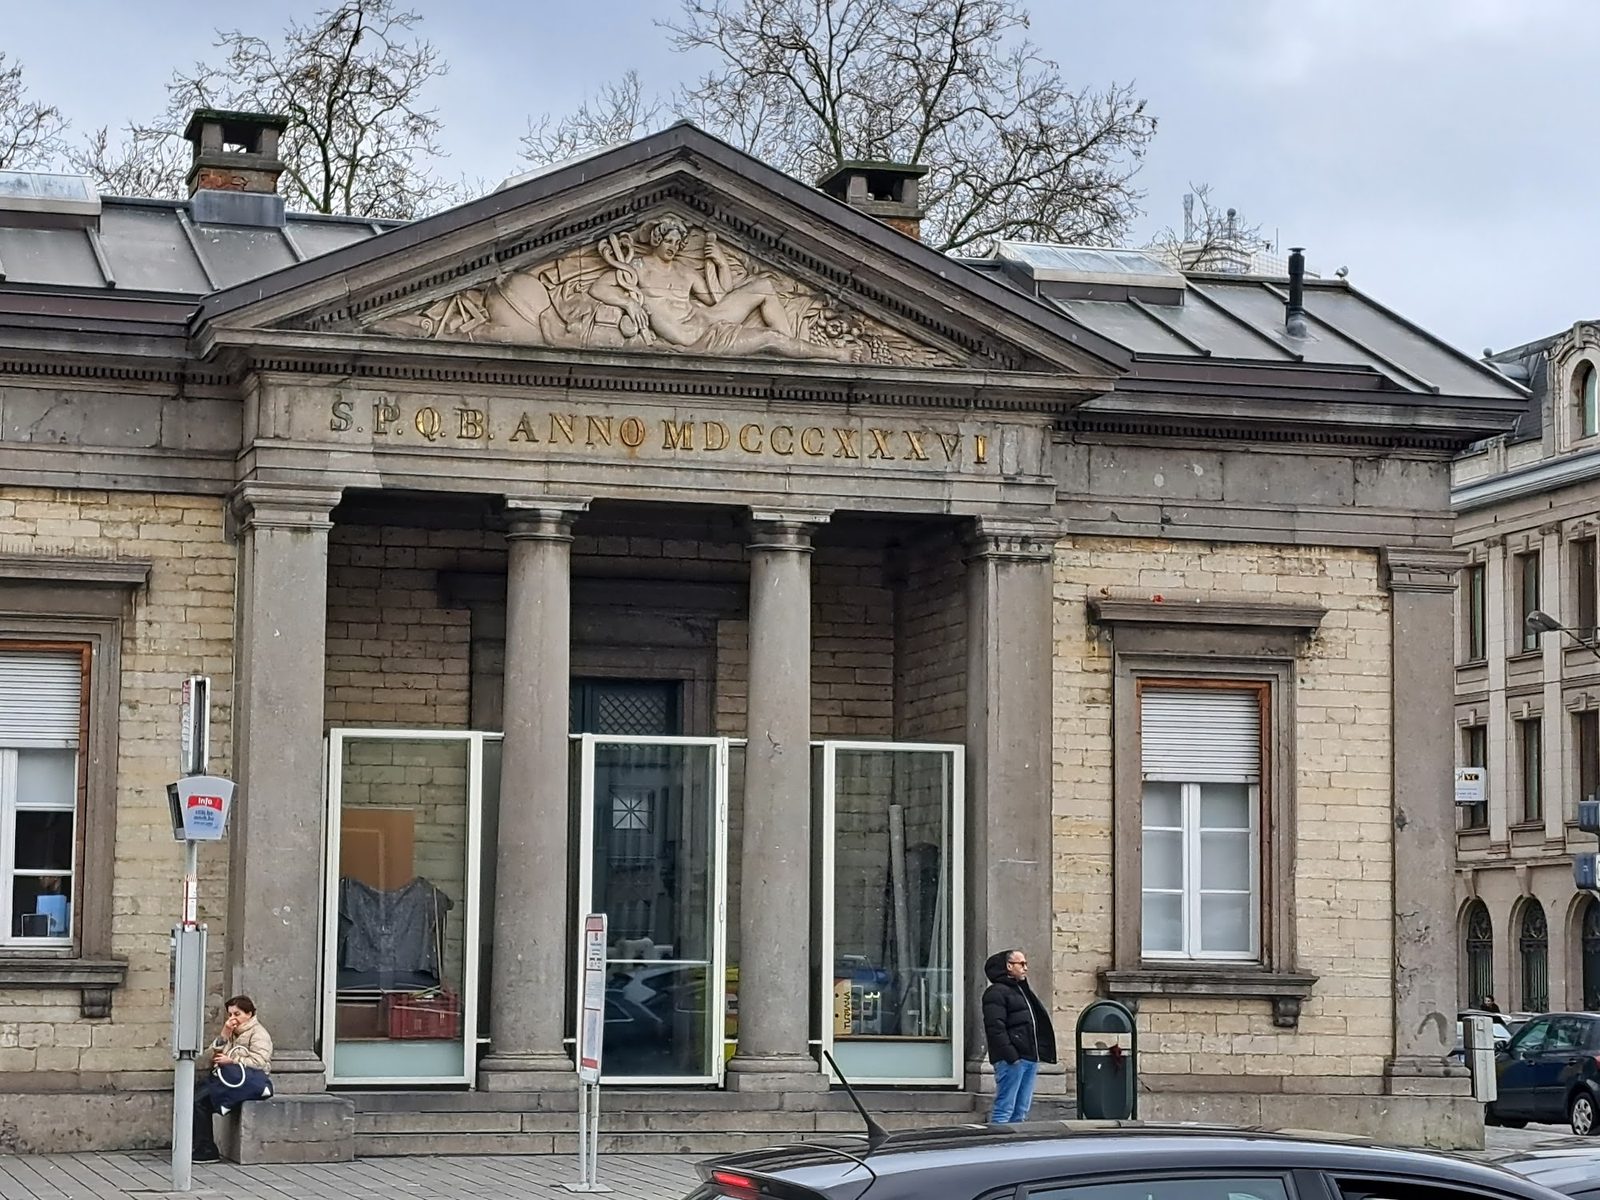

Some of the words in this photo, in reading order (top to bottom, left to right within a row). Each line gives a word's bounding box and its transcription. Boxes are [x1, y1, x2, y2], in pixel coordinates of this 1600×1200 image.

[509, 412, 646, 447] ANNO
[661, 419, 988, 464] MDCCCXXXVI
[198, 797, 213, 805] Info
